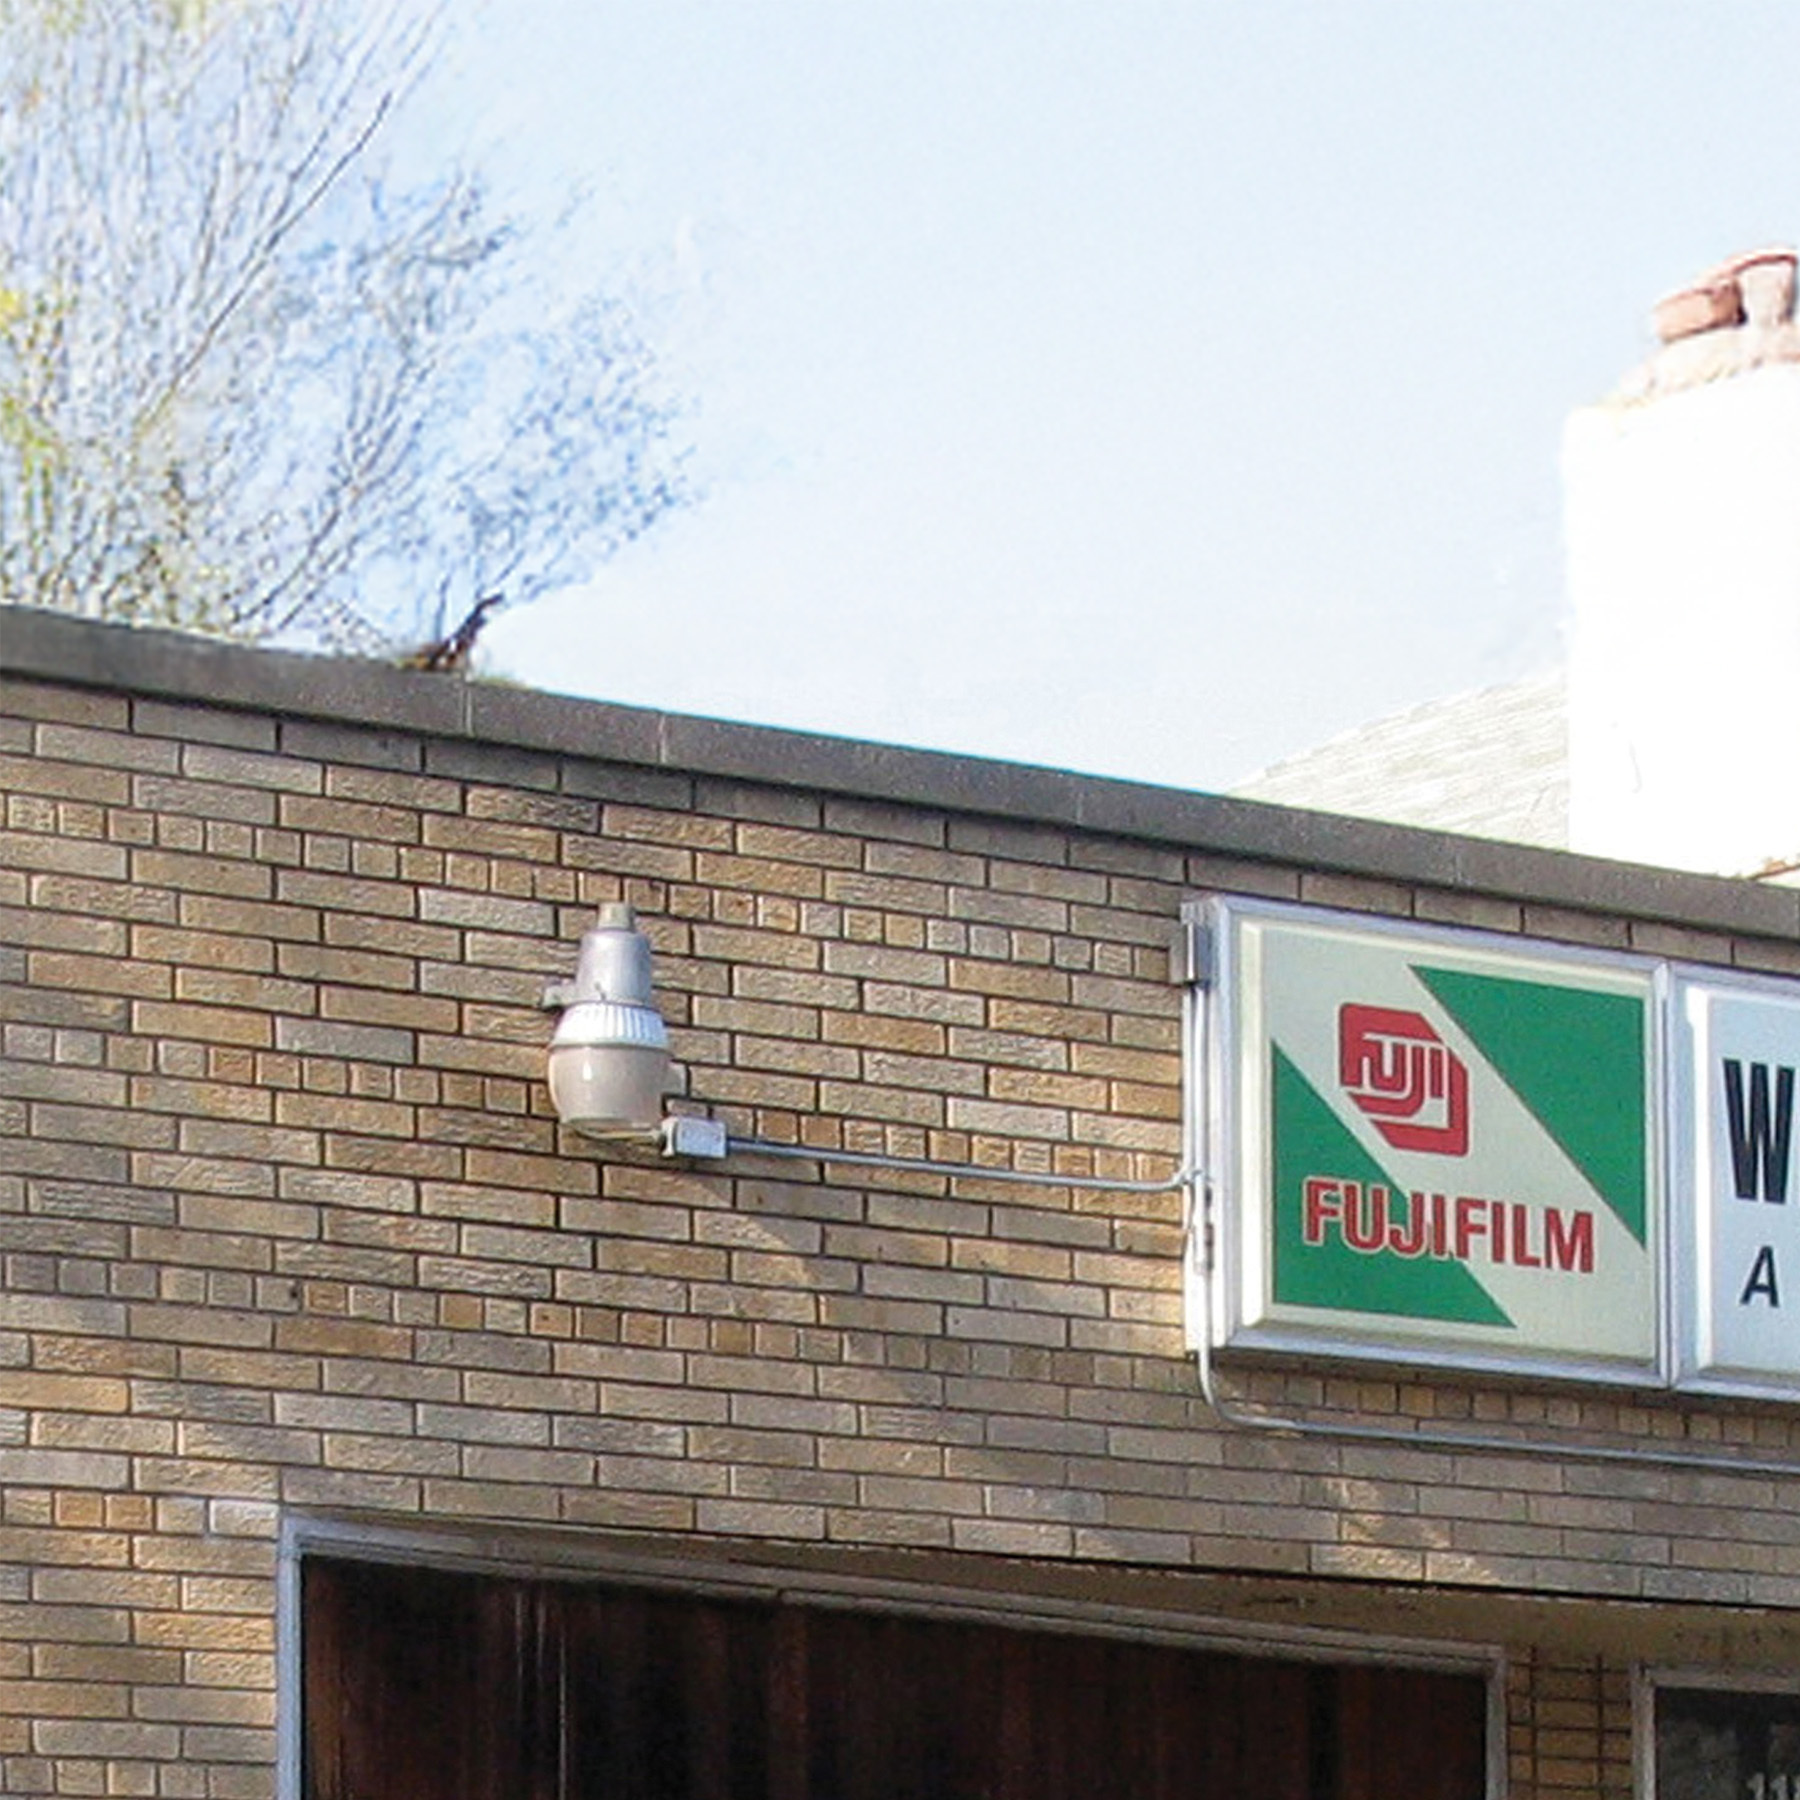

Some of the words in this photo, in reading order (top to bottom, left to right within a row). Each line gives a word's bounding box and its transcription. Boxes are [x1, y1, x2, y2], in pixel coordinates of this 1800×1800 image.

[1339, 1002, 1469, 1158] FUJI
[1305, 1177, 1595, 1275] FUJIFILM
[1739, 1245, 1780, 1309] A
